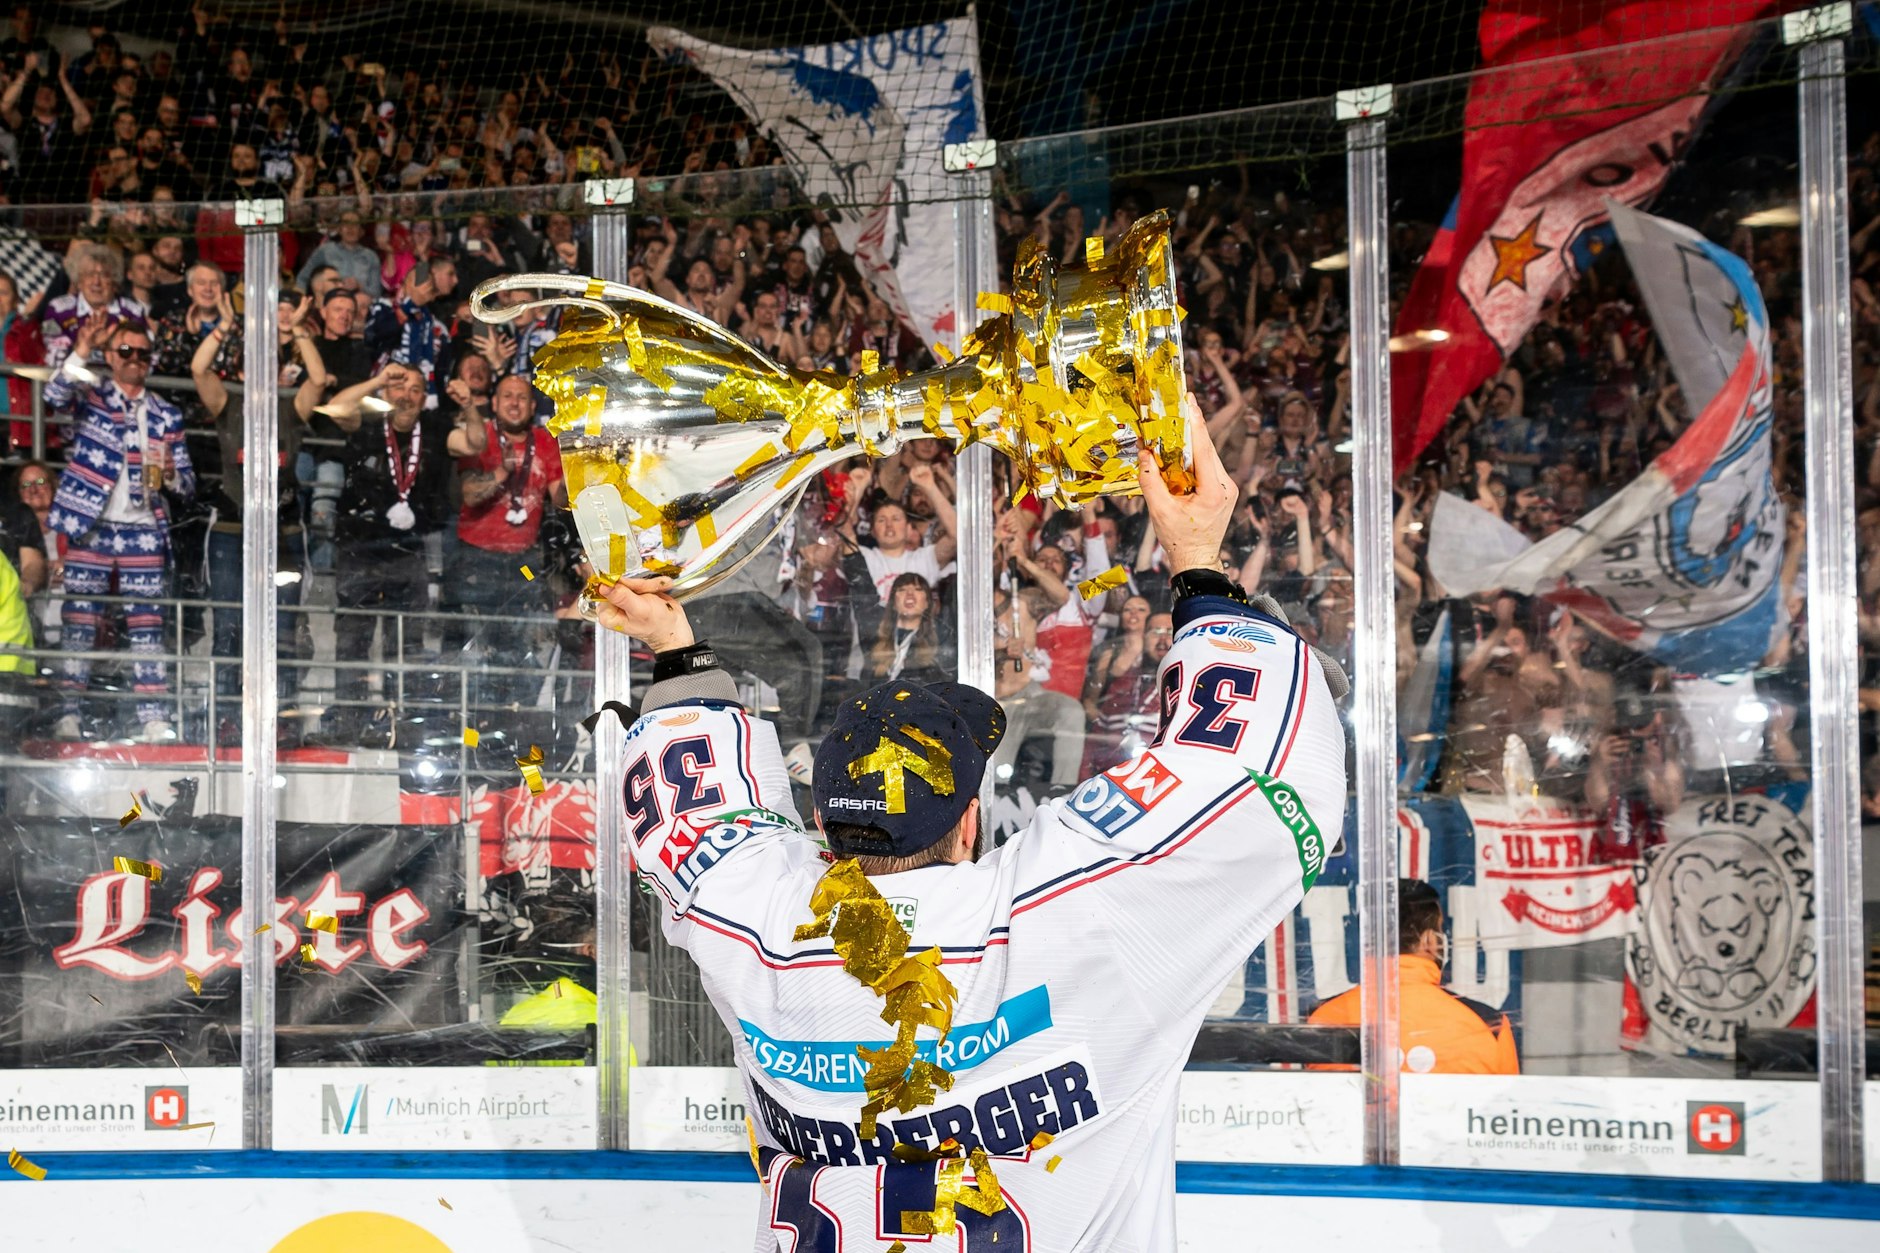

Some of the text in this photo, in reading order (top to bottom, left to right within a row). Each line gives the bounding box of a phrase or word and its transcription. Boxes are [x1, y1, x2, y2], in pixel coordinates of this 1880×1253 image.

[623, 734, 727, 848] 35
[828, 797, 888, 811] GASAG
[1273, 788, 1313, 831] LIGO
[1773, 826, 1815, 922] TEAM
[745, 1033, 872, 1084] ISBÄREN
[477, 1097, 549, 1120] Airport
[1223, 1104, 1306, 1130] Airport
[0, 1124, 44, 1133] nschaft
[65, 1125, 96, 1133] unser
[101, 1124, 135, 1133] Strom
[1467, 1108, 1673, 1141] heinemann
[1467, 1137, 1675, 1155] Leidenschaft ist unser Strom
